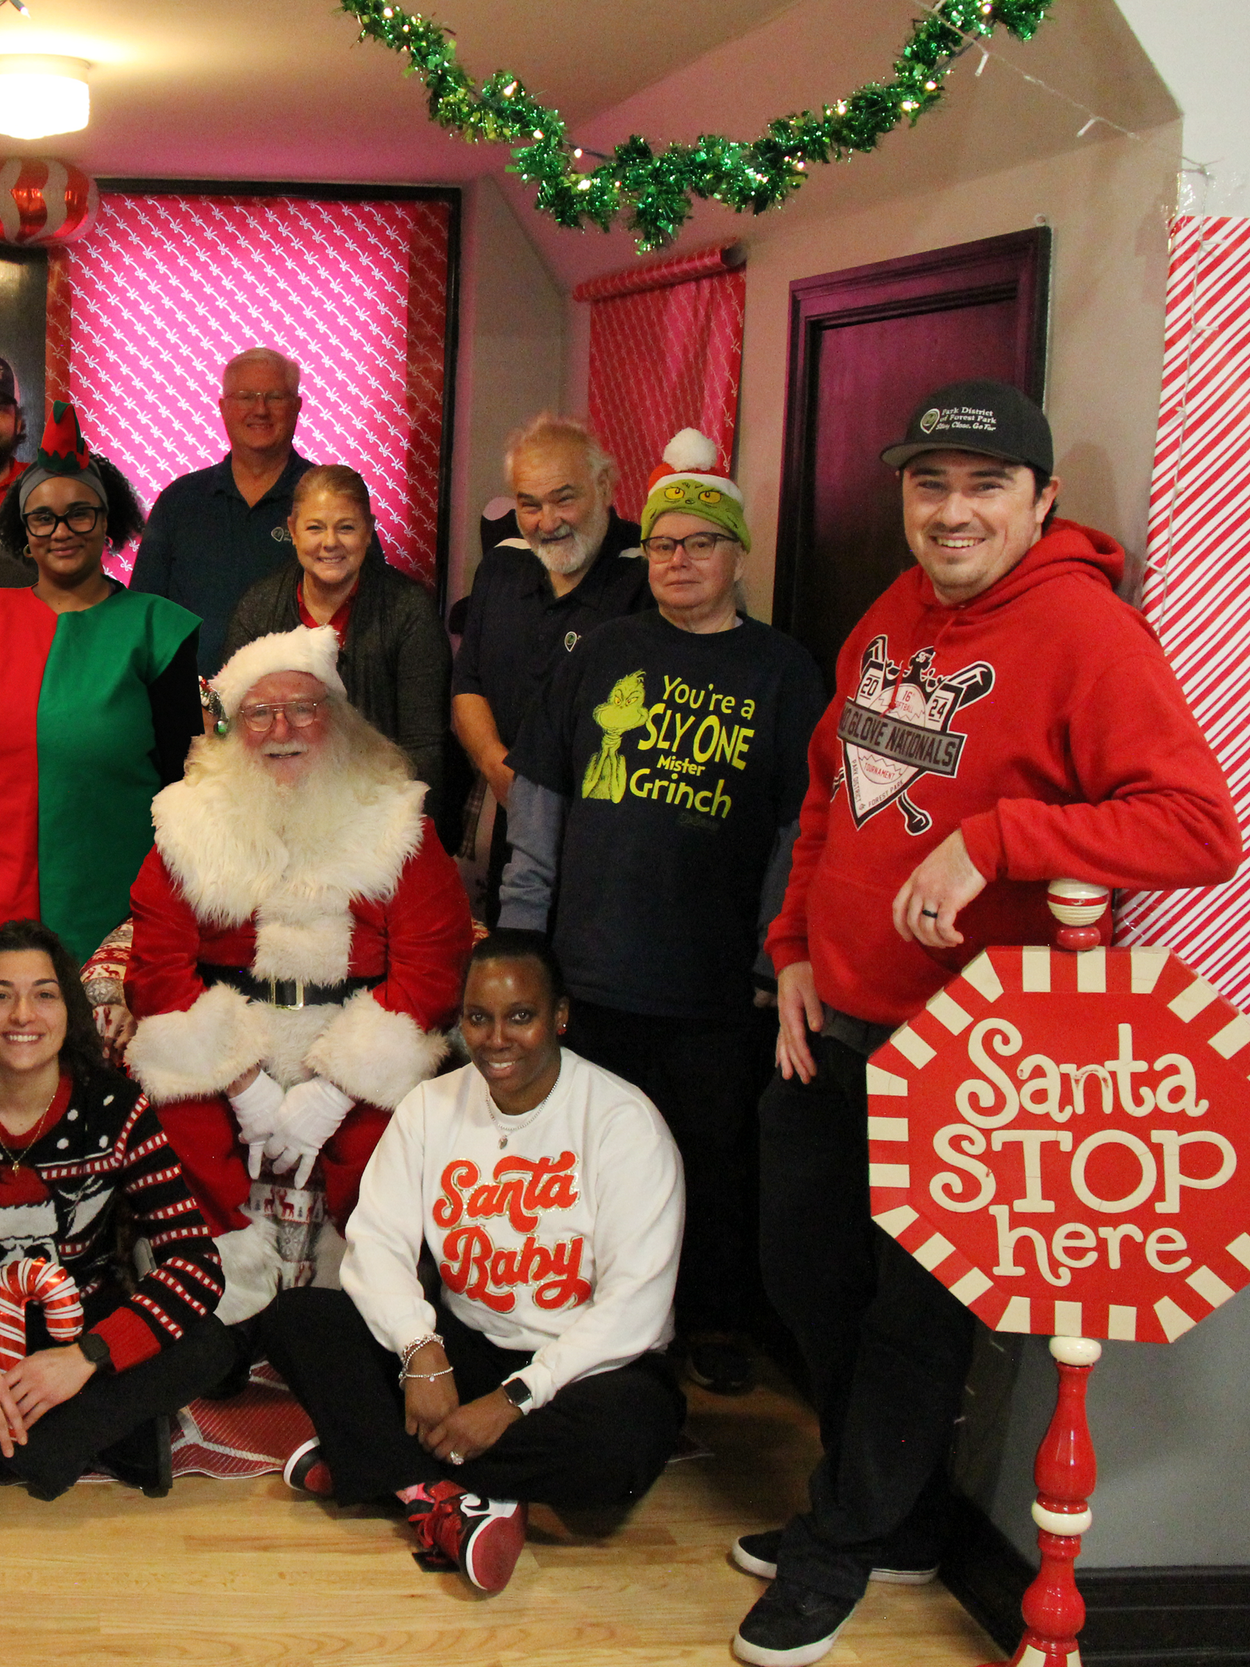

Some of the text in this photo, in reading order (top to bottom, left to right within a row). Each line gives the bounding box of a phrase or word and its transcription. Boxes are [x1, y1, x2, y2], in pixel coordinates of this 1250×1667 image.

[939, 414, 949, 422] of
[977, 415, 997, 424] Park
[941, 406, 993, 417] Park District
[662, 675, 756, 720] You're a
[860, 677, 879, 697] 20
[895, 700, 914, 714] OFTBALL
[928, 698, 948, 720] 24
[637, 702, 755, 770] SLY ONE
[849, 710, 888, 746] GLOVE
[885, 726, 957, 767] NATIONALS
[656, 754, 706, 777] Mister
[864, 762, 895, 779] TOURNAMENT
[629, 768, 732, 818] Grinch
[868, 780, 903, 807] FOREST PARK
[955, 1017, 1209, 1129] Santa
[929, 1122, 1237, 1213] STOP
[432, 1150, 580, 1234] Santa
[988, 1204, 1192, 1287] here
[439, 1224, 592, 1313] Baby
